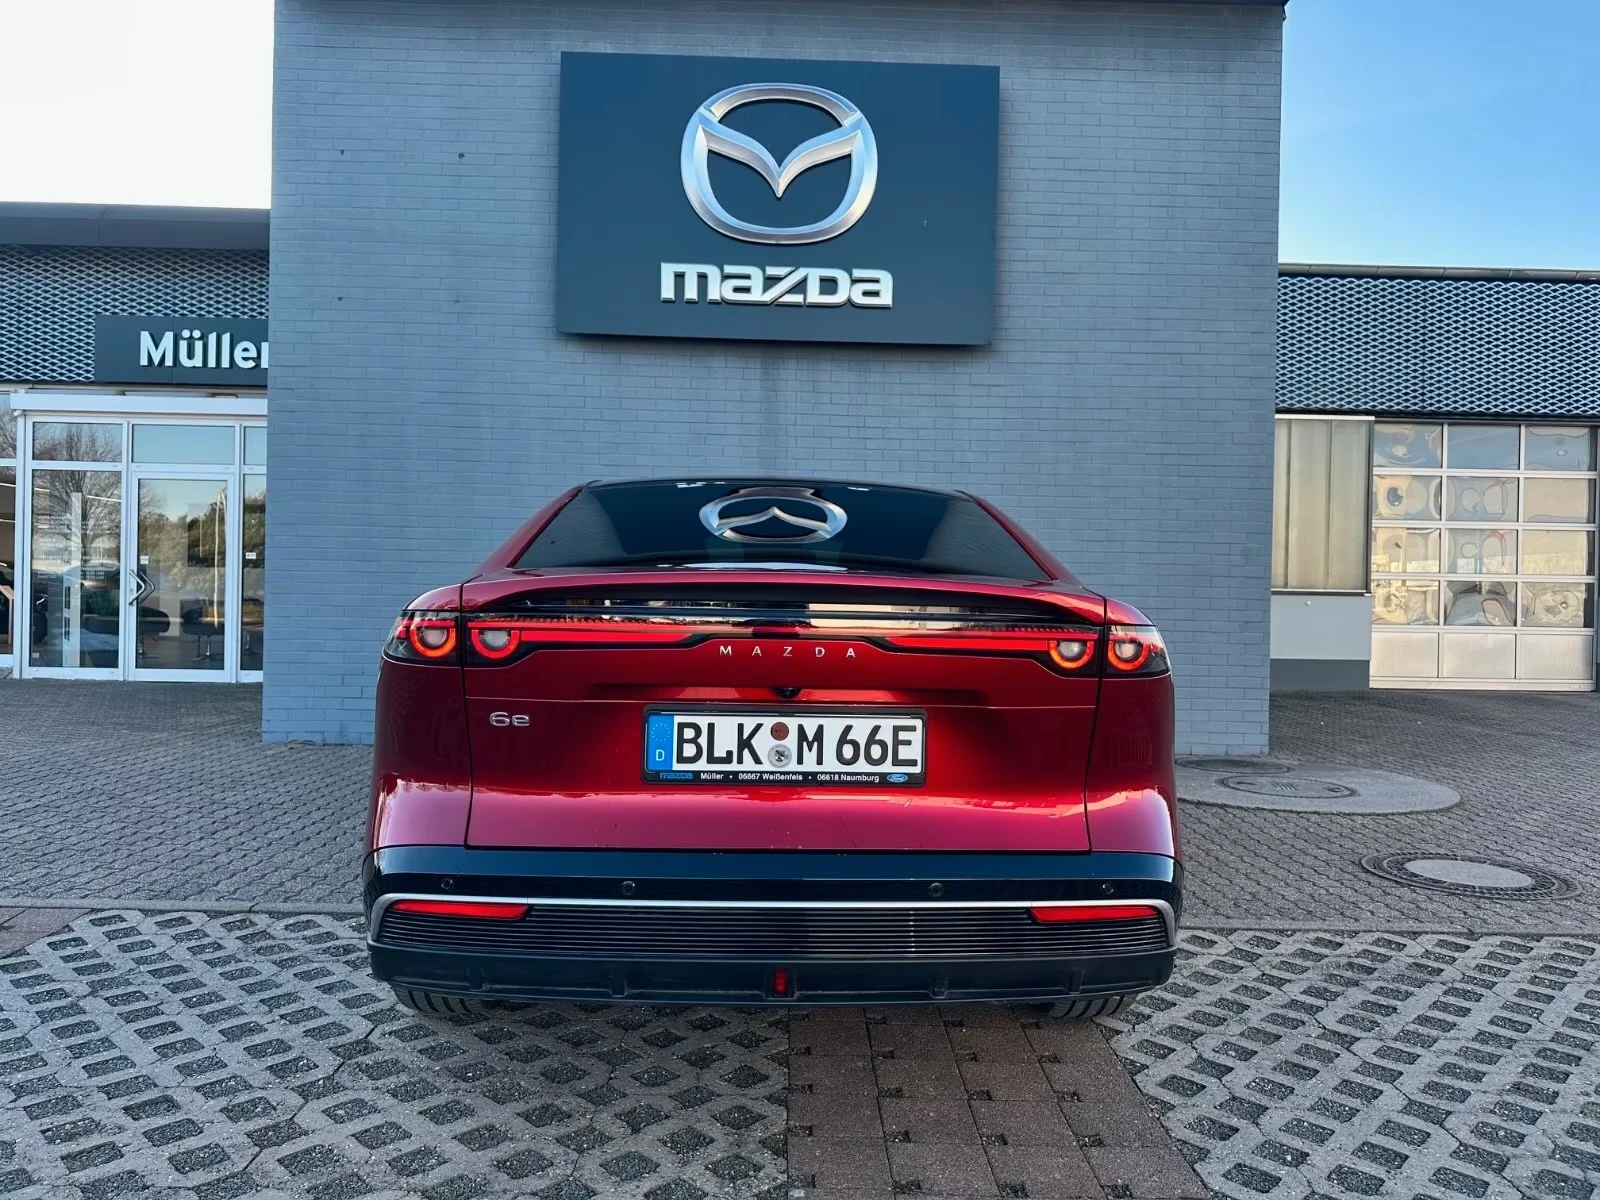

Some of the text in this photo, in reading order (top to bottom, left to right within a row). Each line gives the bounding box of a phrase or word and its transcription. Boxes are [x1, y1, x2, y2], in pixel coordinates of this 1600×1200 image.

[661, 262, 893, 307] mazda
[719, 645, 856, 658] MAZDA
[489, 711, 530, 727] 6e
[676, 721, 764, 765] BLK
[796, 723, 824, 766] M
[836, 724, 918, 767] 66E
[655, 749, 665, 761] D
[840, 774, 880, 783] Naumburg
